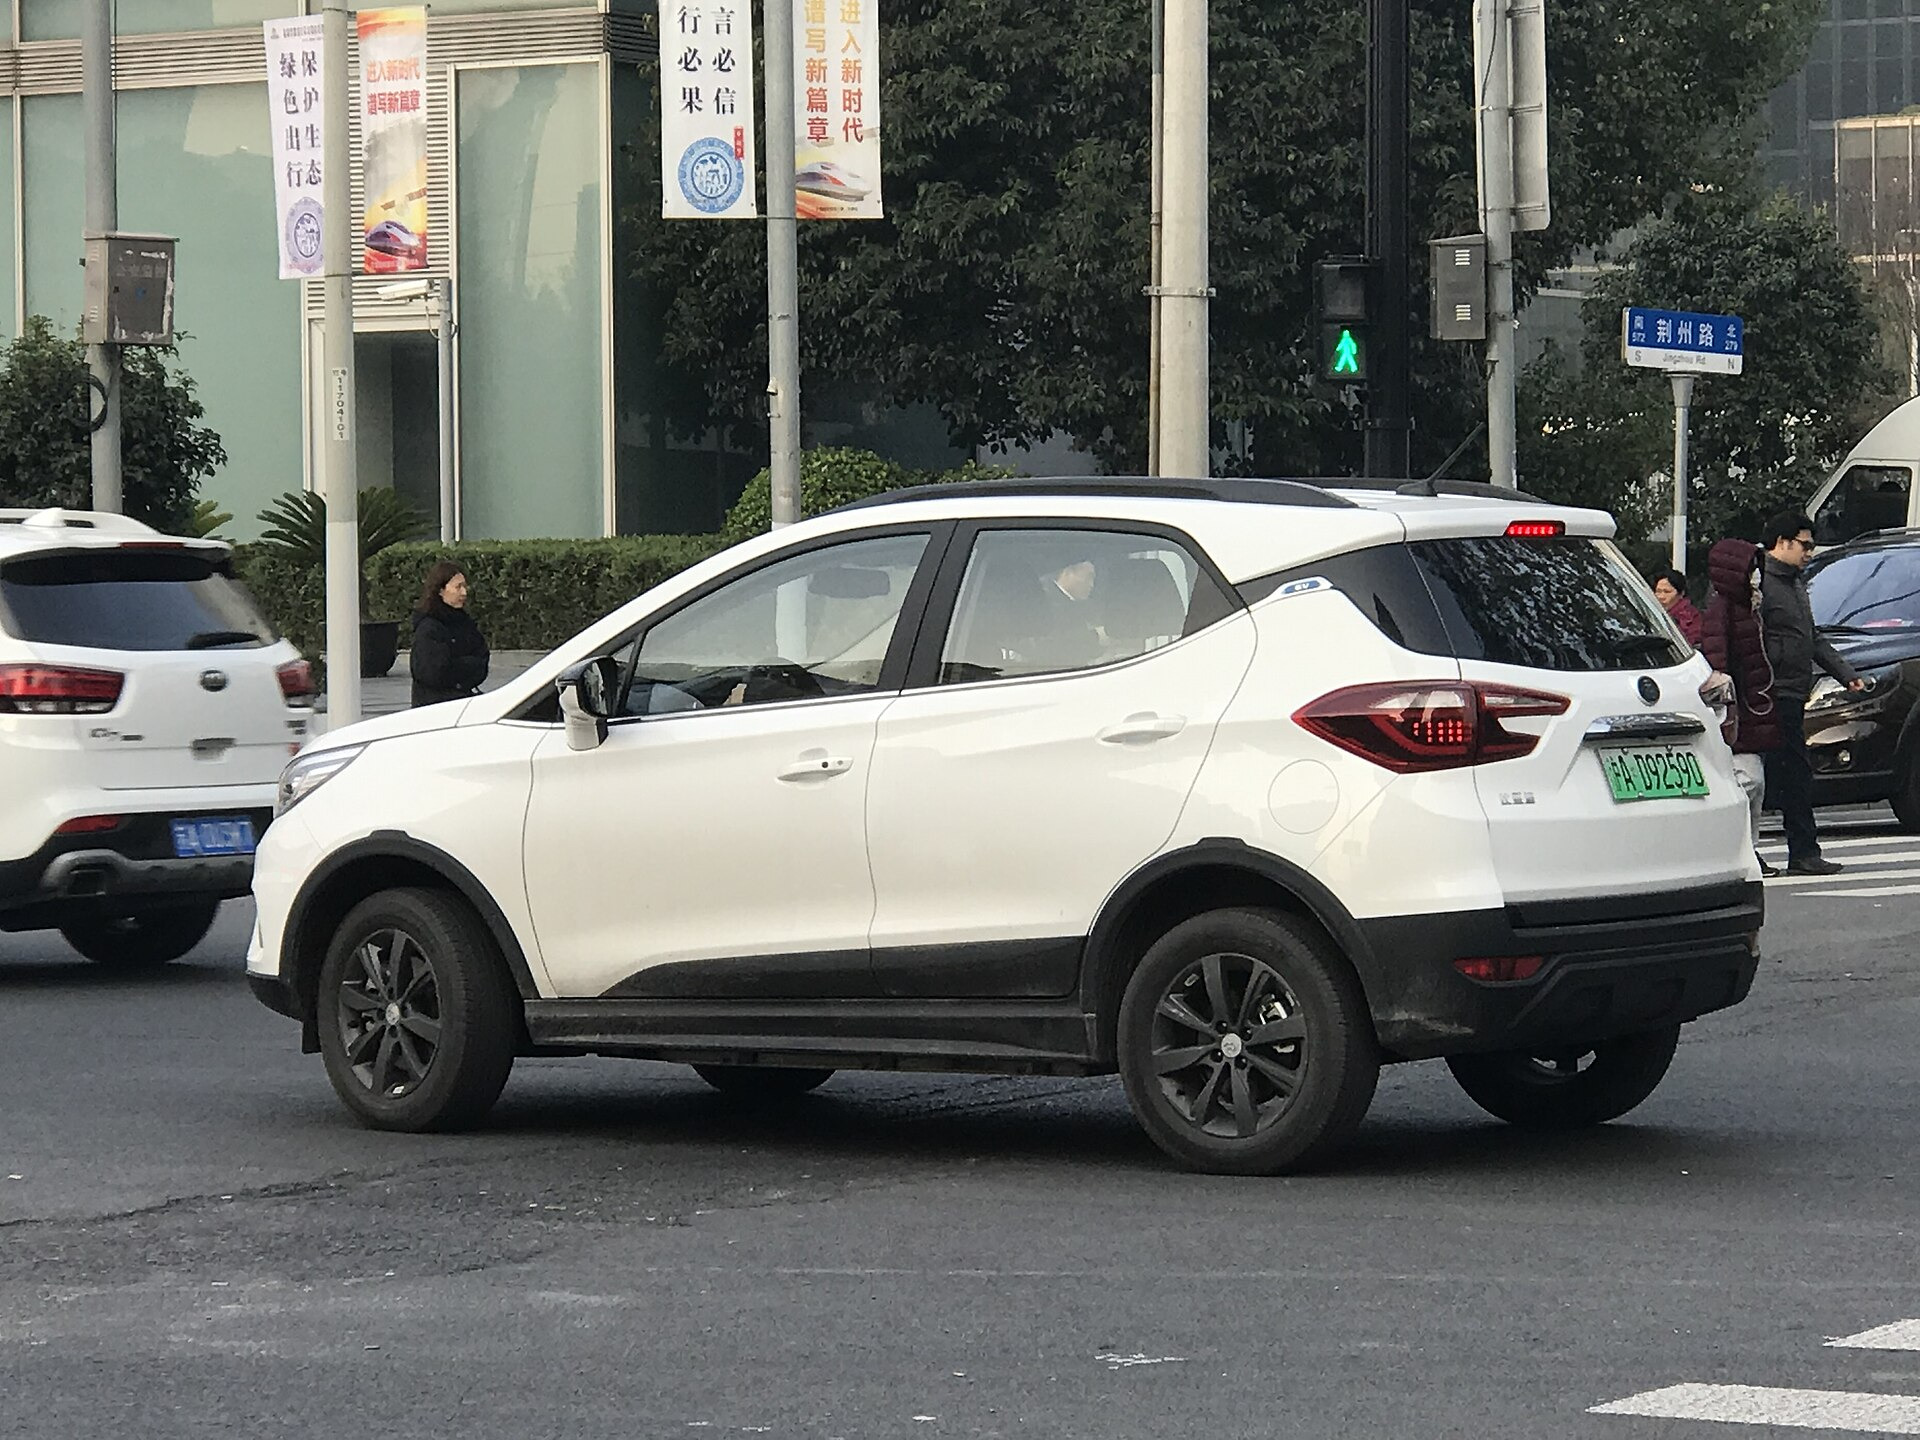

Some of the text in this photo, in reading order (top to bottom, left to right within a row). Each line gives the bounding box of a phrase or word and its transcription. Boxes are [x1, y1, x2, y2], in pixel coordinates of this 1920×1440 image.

[366, 57, 420, 82] 进入新时代
[677, 5, 703, 115] 行必果
[710, 6, 736, 115] 言必信
[803, 0, 829, 143] 谱写新篇章
[839, 0, 864, 144] 进入新时代
[279, 53, 303, 188] 绿色出行
[301, 50, 322, 185] 保护生态
[1634, 350, 1642, 362] S
[1656, 318, 1714, 347] 荆州路
[1726, 323, 1737, 338] 北
